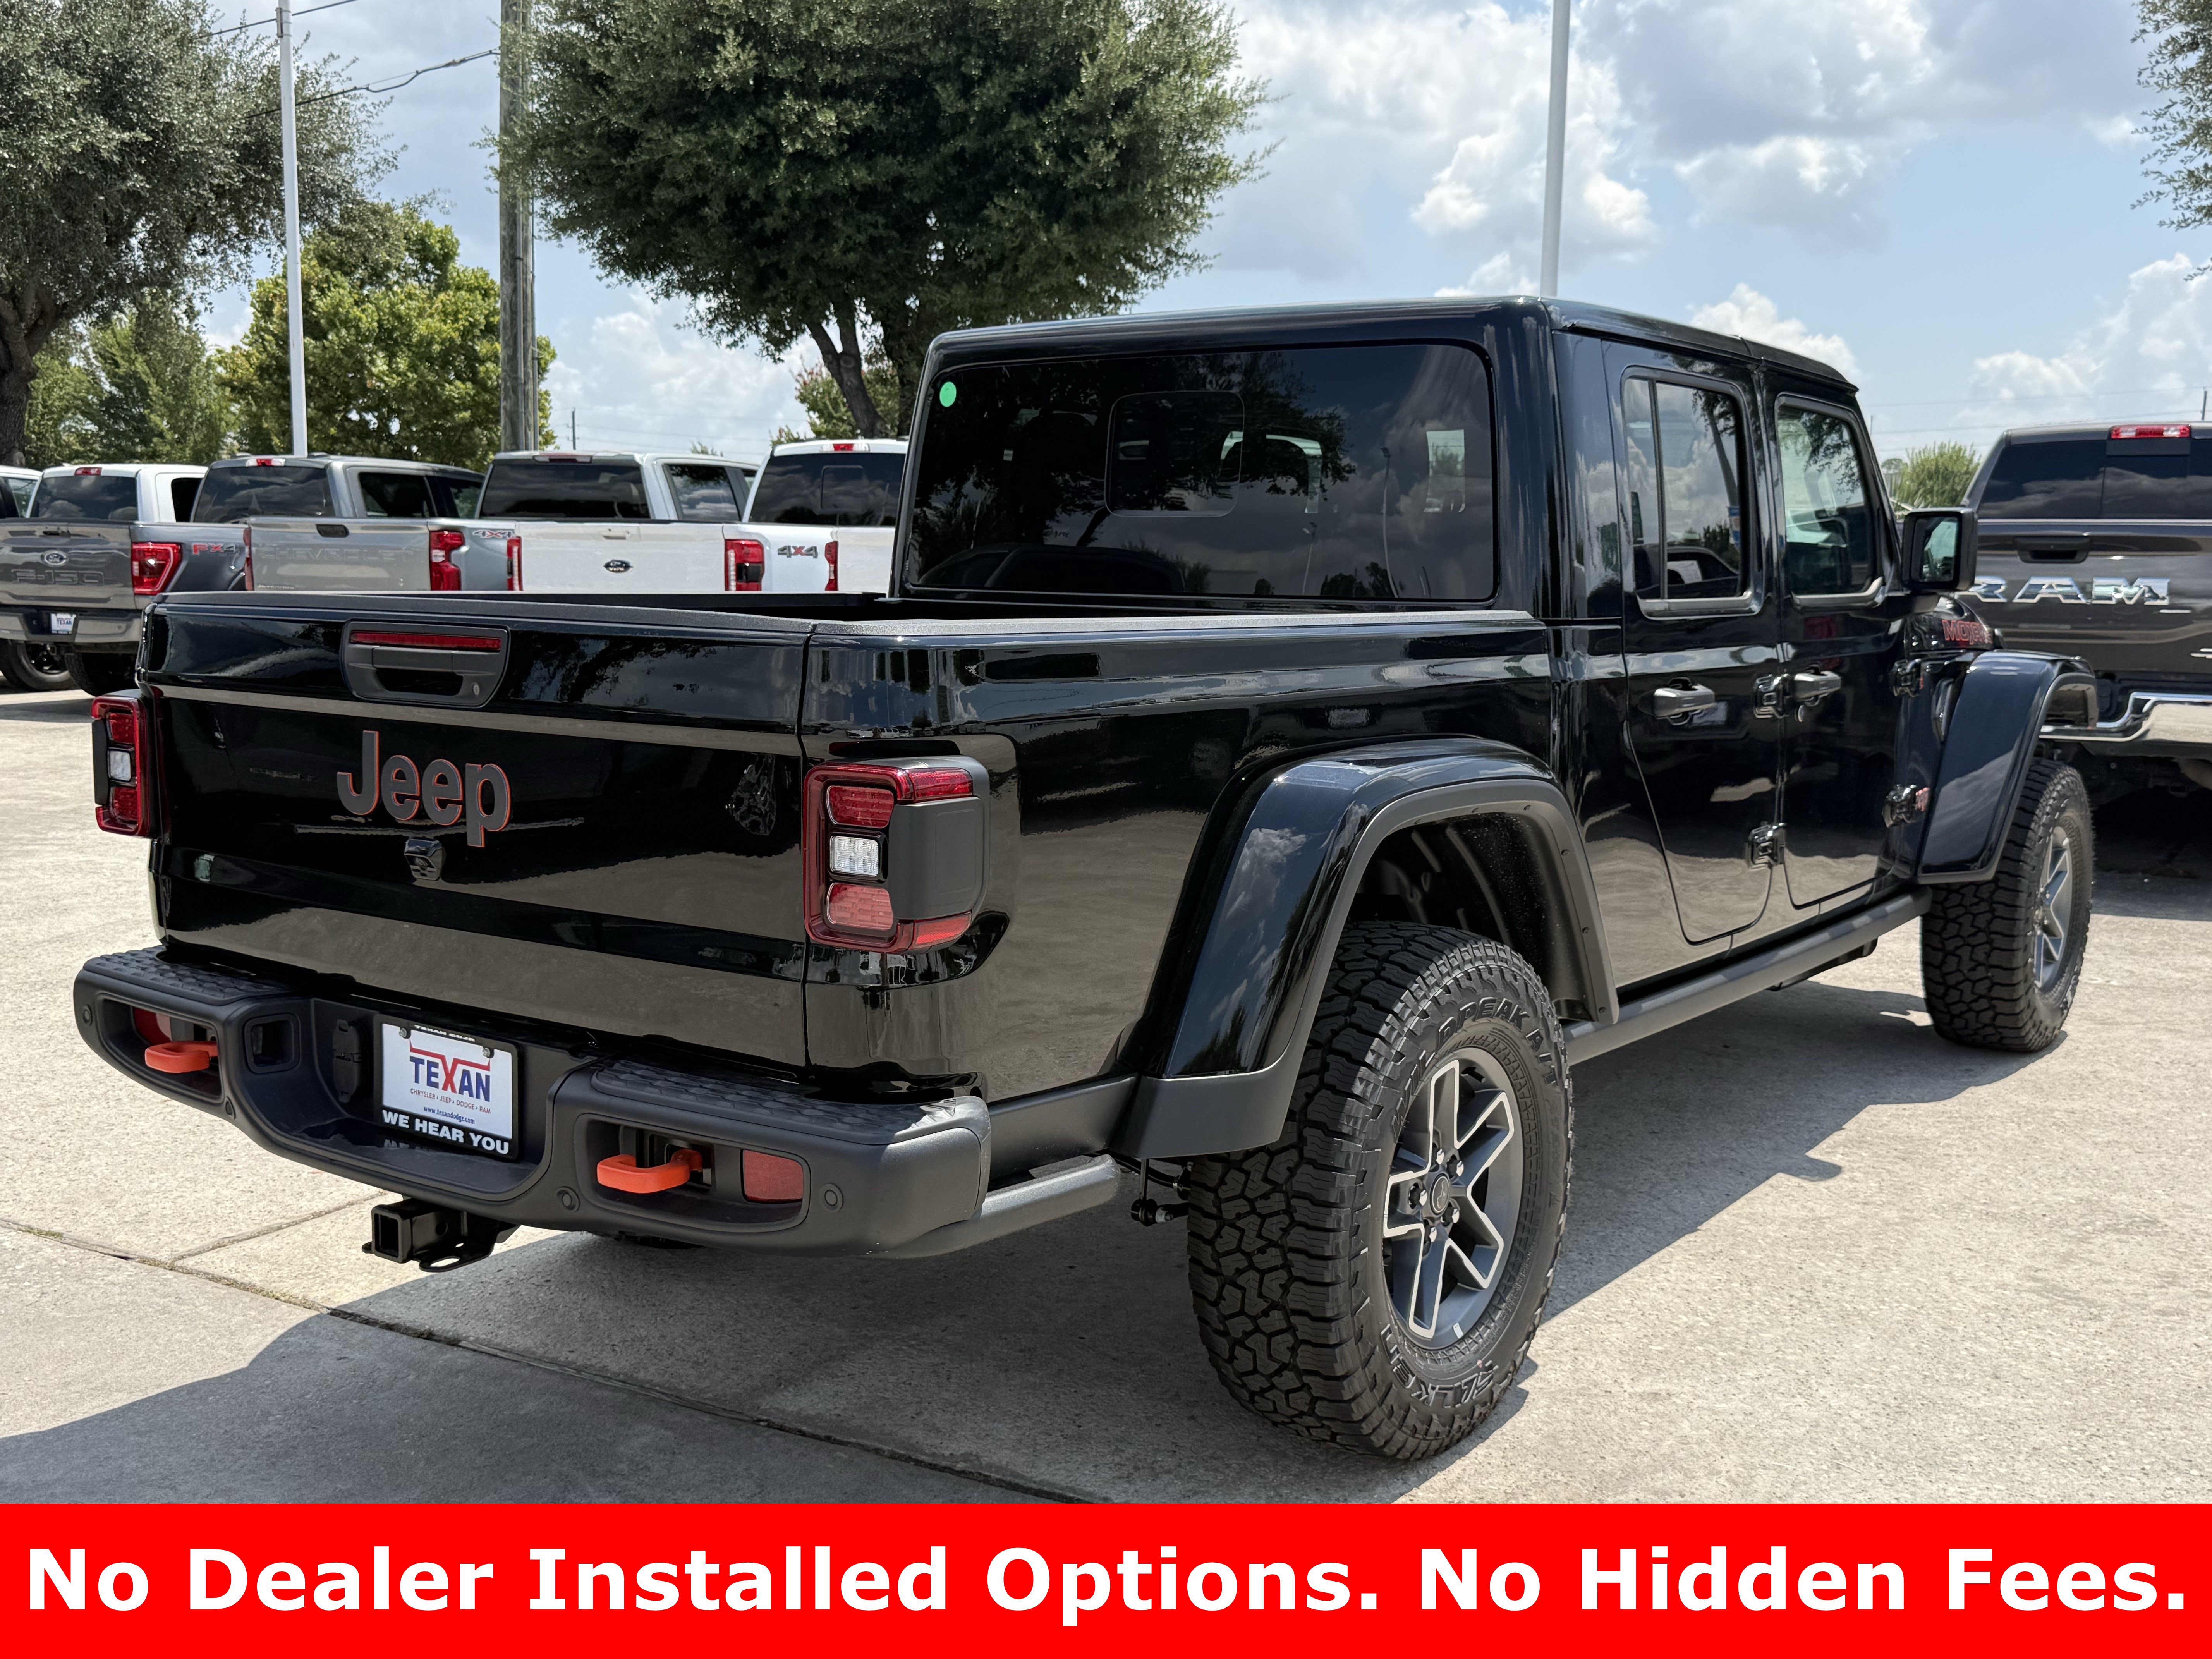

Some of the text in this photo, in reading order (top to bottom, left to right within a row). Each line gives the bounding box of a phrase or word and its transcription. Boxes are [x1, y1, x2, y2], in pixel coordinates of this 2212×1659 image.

[11, 568, 105, 585] F-150
[1954, 575, 2170, 605] RAM
[337, 730, 511, 847] Jeep
[414, 1024, 447, 1035] TEXAN
[409, 1048, 490, 1102] TEXAN
[410, 1088, 491, 1114] CHRYSLER JEEP DODGE RAM
[424, 1106, 475, 1125] www.texandodge.com
[382, 1109, 509, 1154] WE HEAR YOU
